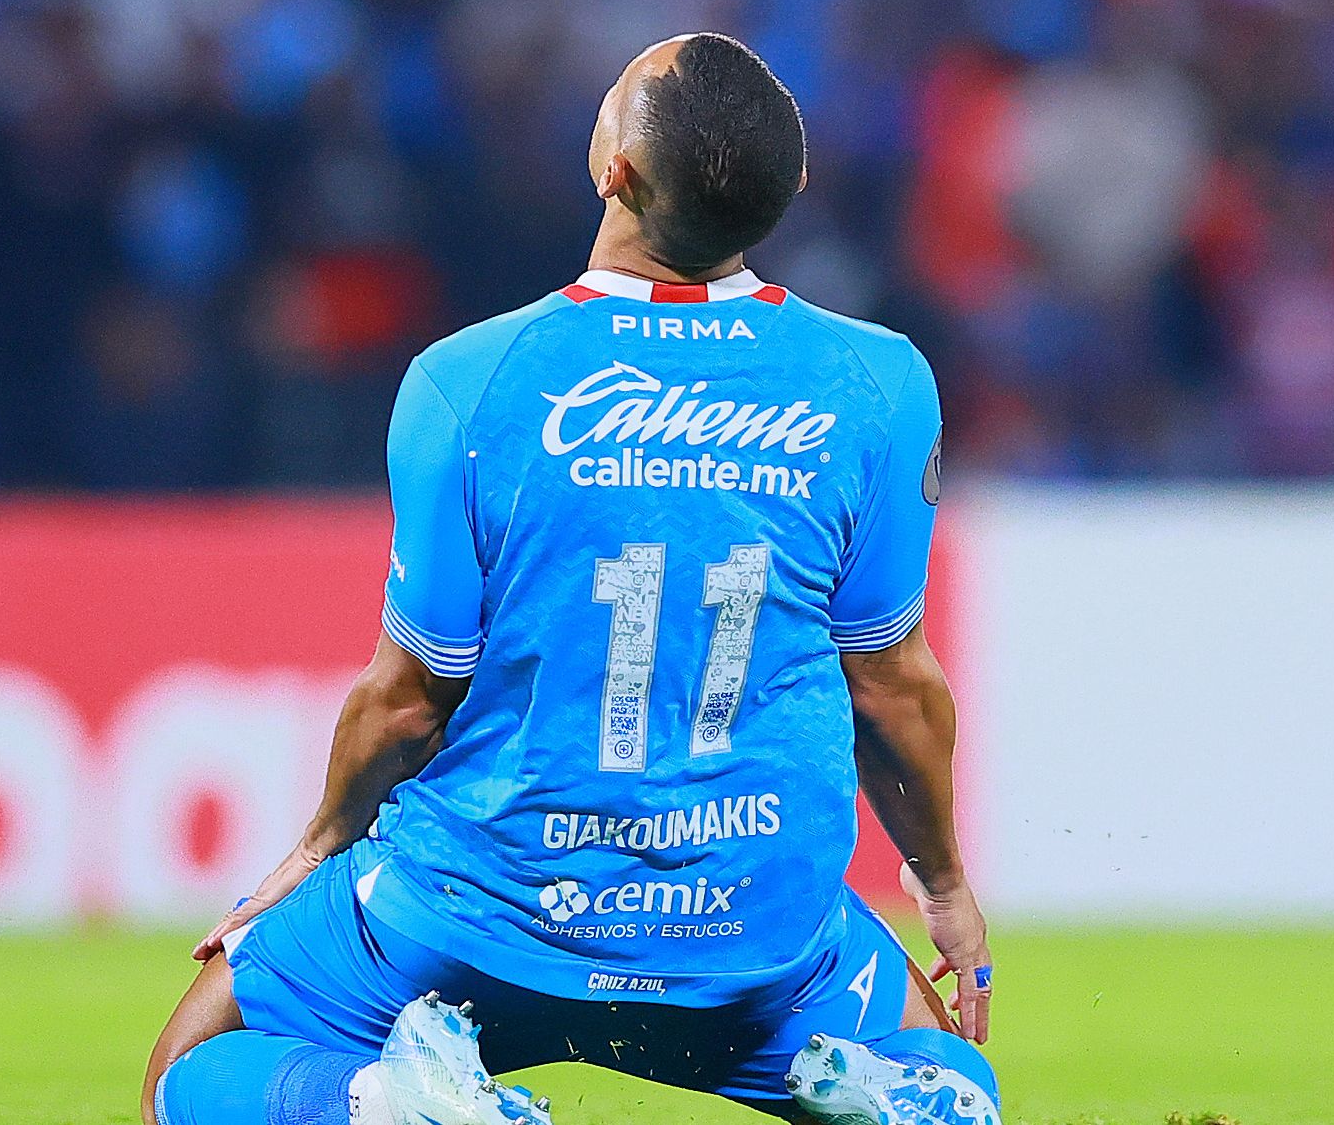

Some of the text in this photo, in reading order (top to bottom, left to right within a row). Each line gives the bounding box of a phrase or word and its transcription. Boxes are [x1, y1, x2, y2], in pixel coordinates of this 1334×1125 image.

[611, 314, 756, 340] PIRMA
[539, 359, 837, 456] Caliente
[569, 447, 817, 500] caliente.mx
[591, 542, 771, 772] 11
[542, 793, 781, 851] GIAKOUMAKIS
[593, 877, 736, 915] cemix
[645, 924, 657, 938] Y
[660, 920, 744, 938] ESTUCOS
[587, 972, 666, 993] CRUZ AZUL
